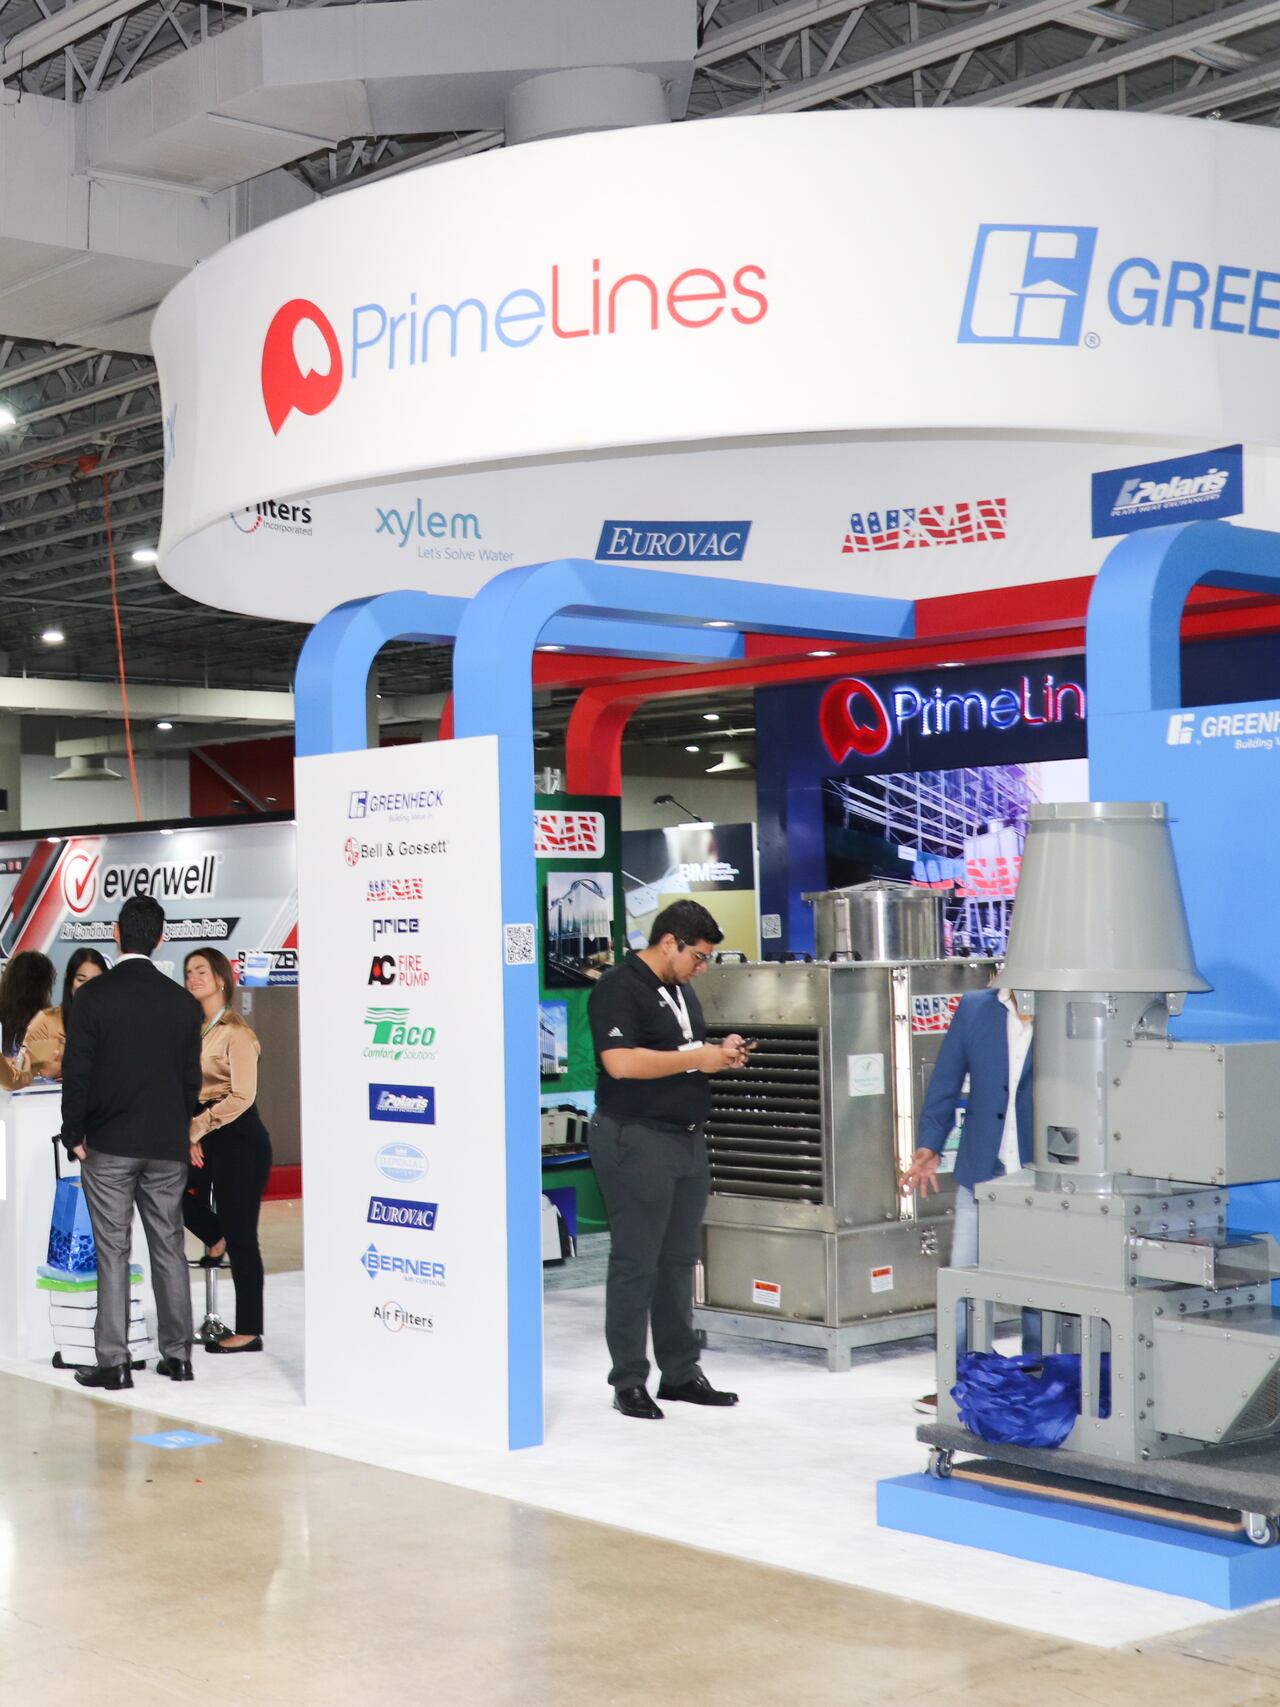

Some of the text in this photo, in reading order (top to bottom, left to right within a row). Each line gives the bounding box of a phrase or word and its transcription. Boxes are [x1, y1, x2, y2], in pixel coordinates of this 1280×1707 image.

[351, 259, 768, 378] PrimeLines
[1130, 467, 1230, 505] Polaris
[376, 498, 482, 547] xylem
[417, 546, 515, 562] Let's Solve Water
[606, 526, 741, 557] EUROVAC
[893, 674, 1085, 736] PrimeLin
[1234, 737, 1273, 750] Building
[370, 790, 444, 813] GREENHECK
[361, 844, 383, 858] Bell
[386, 842, 395, 857] &
[398, 840, 448, 857] Gossett
[104, 855, 215, 898] everwell
[679, 863, 711, 881] BIM
[373, 918, 420, 942] price
[368, 954, 423, 986] AC FIRE
[399, 972, 430, 987] PUMP
[371, 1201, 434, 1228] EUROVAC
[367, 1253, 446, 1280] BERNER
[373, 1306, 434, 1329] Air Filters
